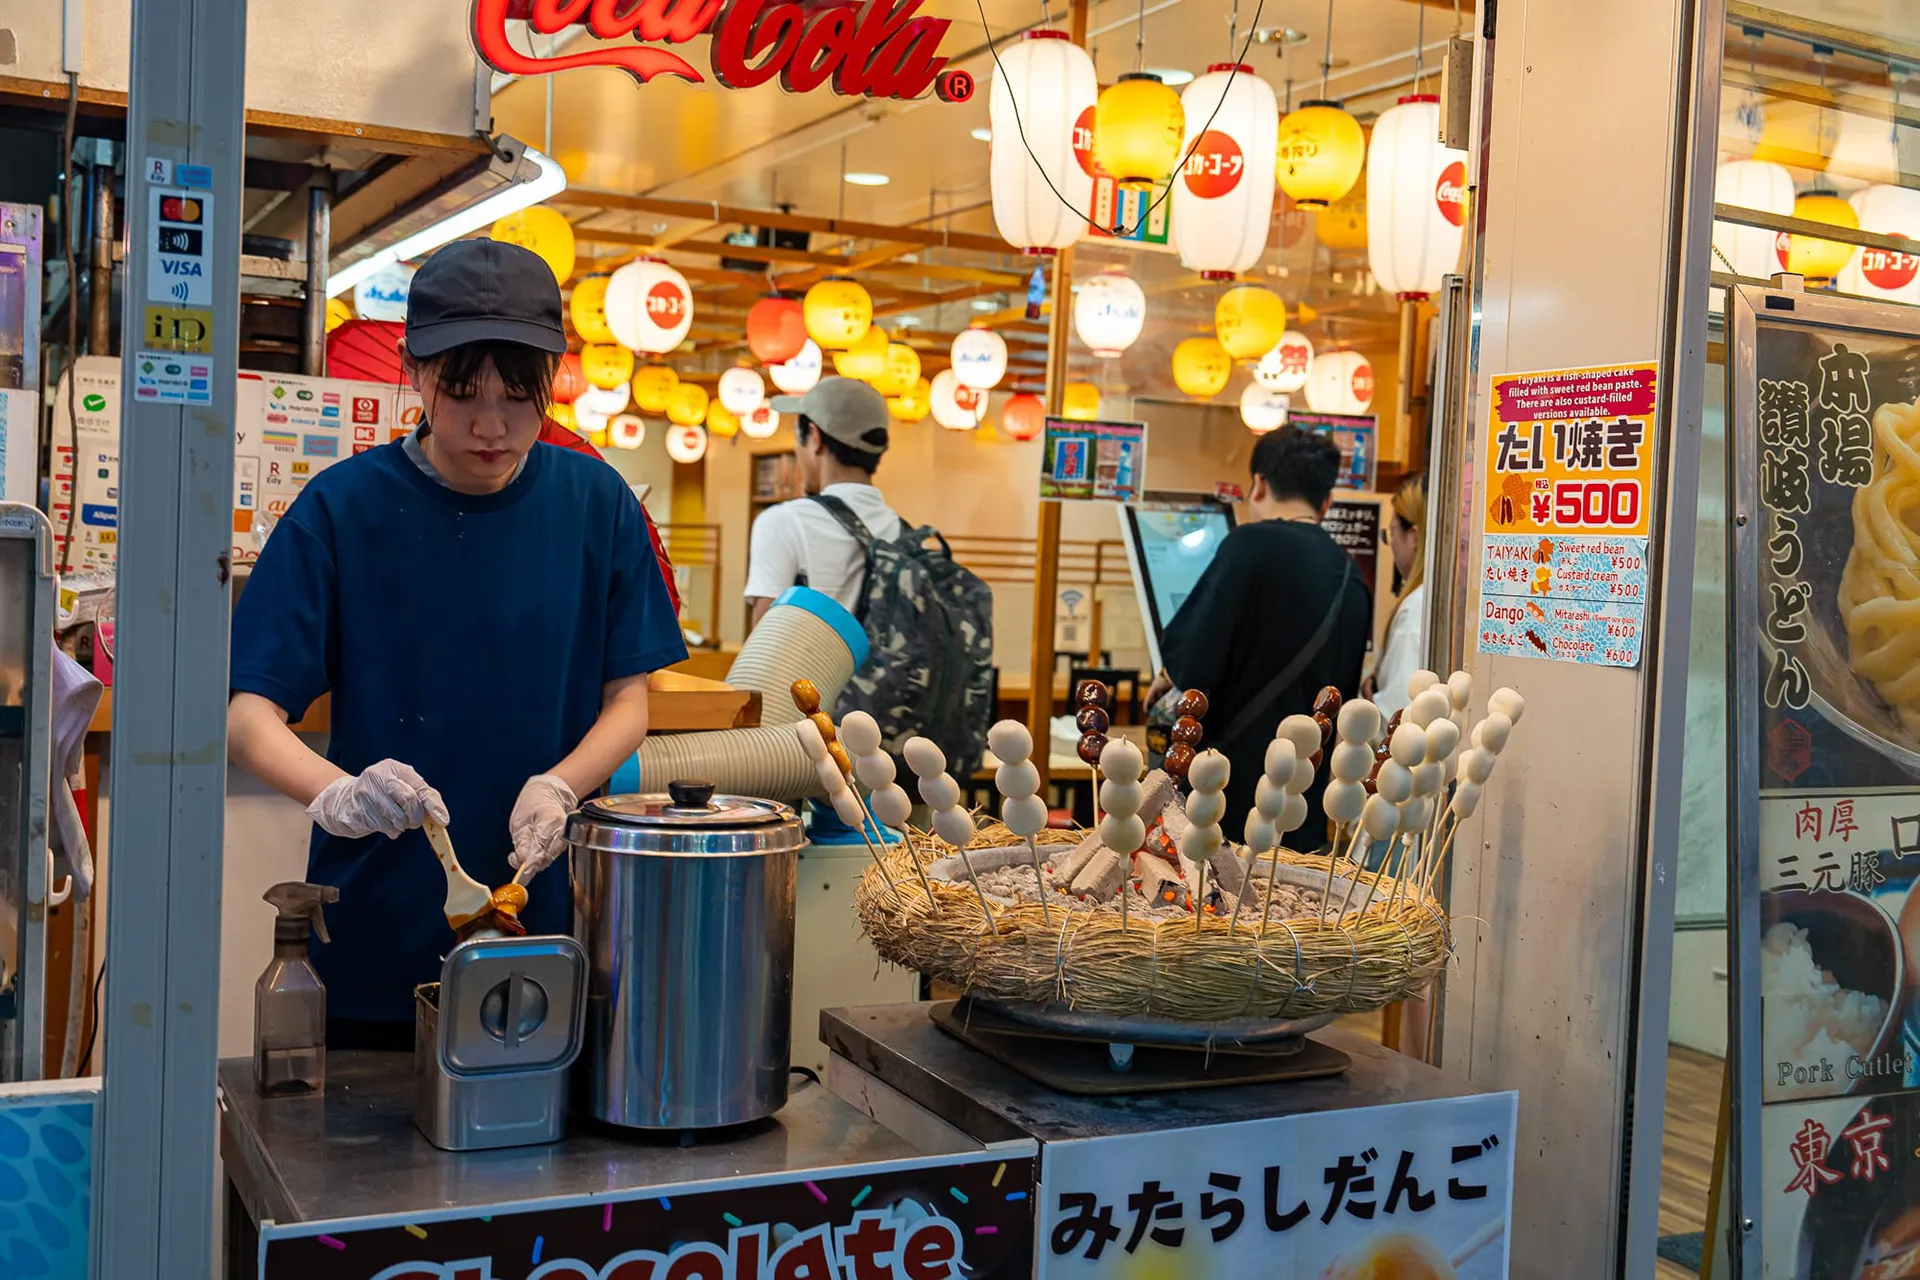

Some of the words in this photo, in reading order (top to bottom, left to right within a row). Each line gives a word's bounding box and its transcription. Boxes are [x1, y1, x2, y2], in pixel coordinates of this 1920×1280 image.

[161, 259, 203, 278] VISA
[1517, 374, 1546, 386] Taiyaki
[1547, 375, 1555, 383] is
[1563, 369, 1612, 382] fish-shaped
[1613, 367, 1634, 377] cake
[1508, 386, 1529, 397] filled
[1531, 385, 1549, 396] with
[1550, 384, 1575, 395] sweet
[1576, 382, 1591, 393] red
[1592, 380, 1613, 391] bean
[1615, 380, 1643, 391] paste.
[1516, 398, 1539, 409] There
[1540, 399, 1554, 408] are
[1555, 396, 1572, 406] also
[1574, 391, 1633, 405] custard-filled
[1533, 408, 1568, 420] versions
[1569, 405, 1611, 418] available.
[1818, 343, 1874, 488] 本場
[1496, 418, 1644, 471] たい焼き
[1532, 483, 1639, 524] ¥500
[1487, 545, 1532, 561] TAIYAKI
[1558, 541, 1585, 553] Sweet
[1587, 541, 1601, 554] red
[1603, 541, 1625, 554] bean
[1611, 556, 1641, 569] ¥500
[1485, 565, 1529, 582] たい焼き
[1556, 567, 1591, 581] Custard
[1592, 571, 1618, 581] cream
[1609, 583, 1639, 597] ¥500
[1485, 600, 1525, 625] Dango
[1554, 608, 1591, 621] Mitarashi
[1482, 631, 1525, 646] 焼きだんご
[1607, 624, 1636, 638] ¥600
[1552, 636, 1596, 652] Chocolate
[1605, 647, 1633, 662] ¥600
[1795, 798, 1860, 842] 肉厚
[1769, 849, 1887, 895] 三元豚
[1777, 1057, 1835, 1087] Pork
[1844, 1051, 1914, 1080] Cutlet
[1783, 1108, 1893, 1198] 東京
[1049, 1133, 1500, 1261] みたらしだんご
